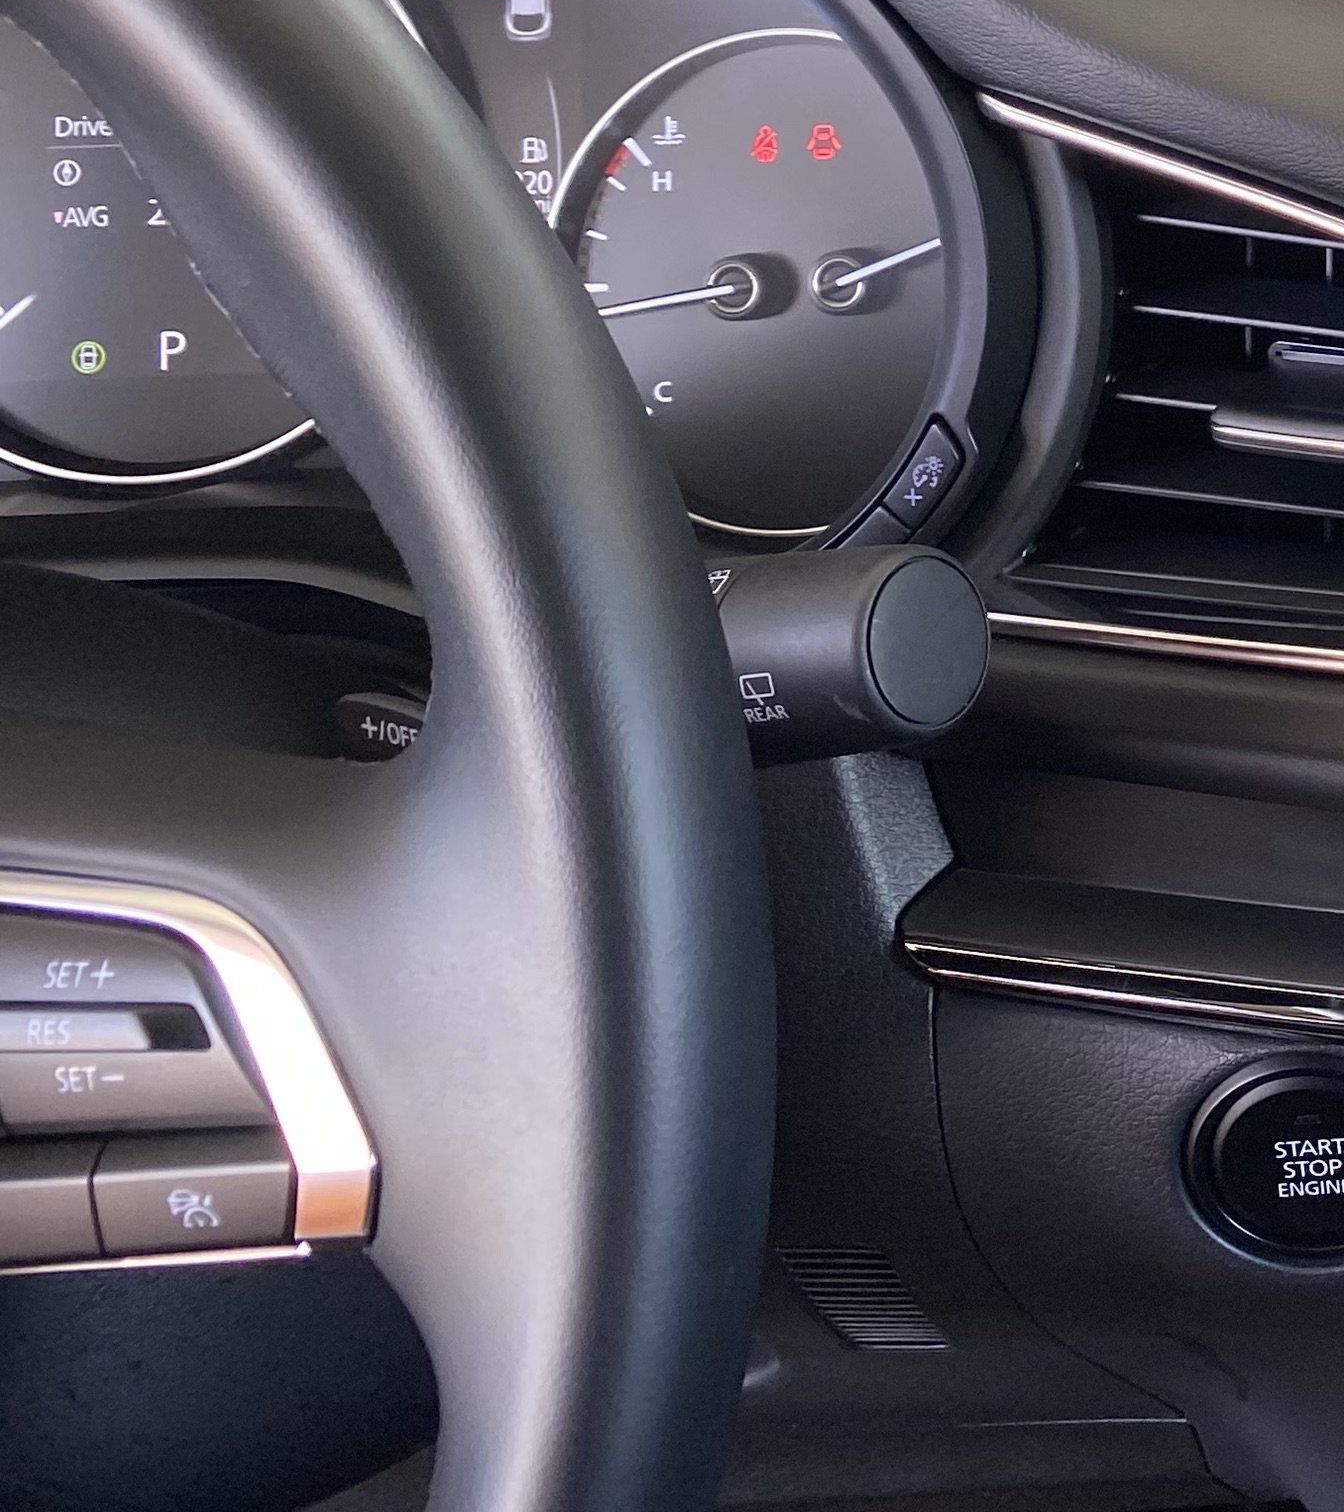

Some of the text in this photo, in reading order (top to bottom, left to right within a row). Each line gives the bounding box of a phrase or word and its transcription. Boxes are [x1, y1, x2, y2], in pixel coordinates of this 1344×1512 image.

[652, 170, 673, 192] H
[62, 205, 109, 228] AVG
[160, 330, 188, 372] P
[654, 381, 673, 403] C
[743, 704, 790, 723] REAR
[27, 1017, 71, 1046] RES
[1283, 1158, 1343, 1179] STOP
